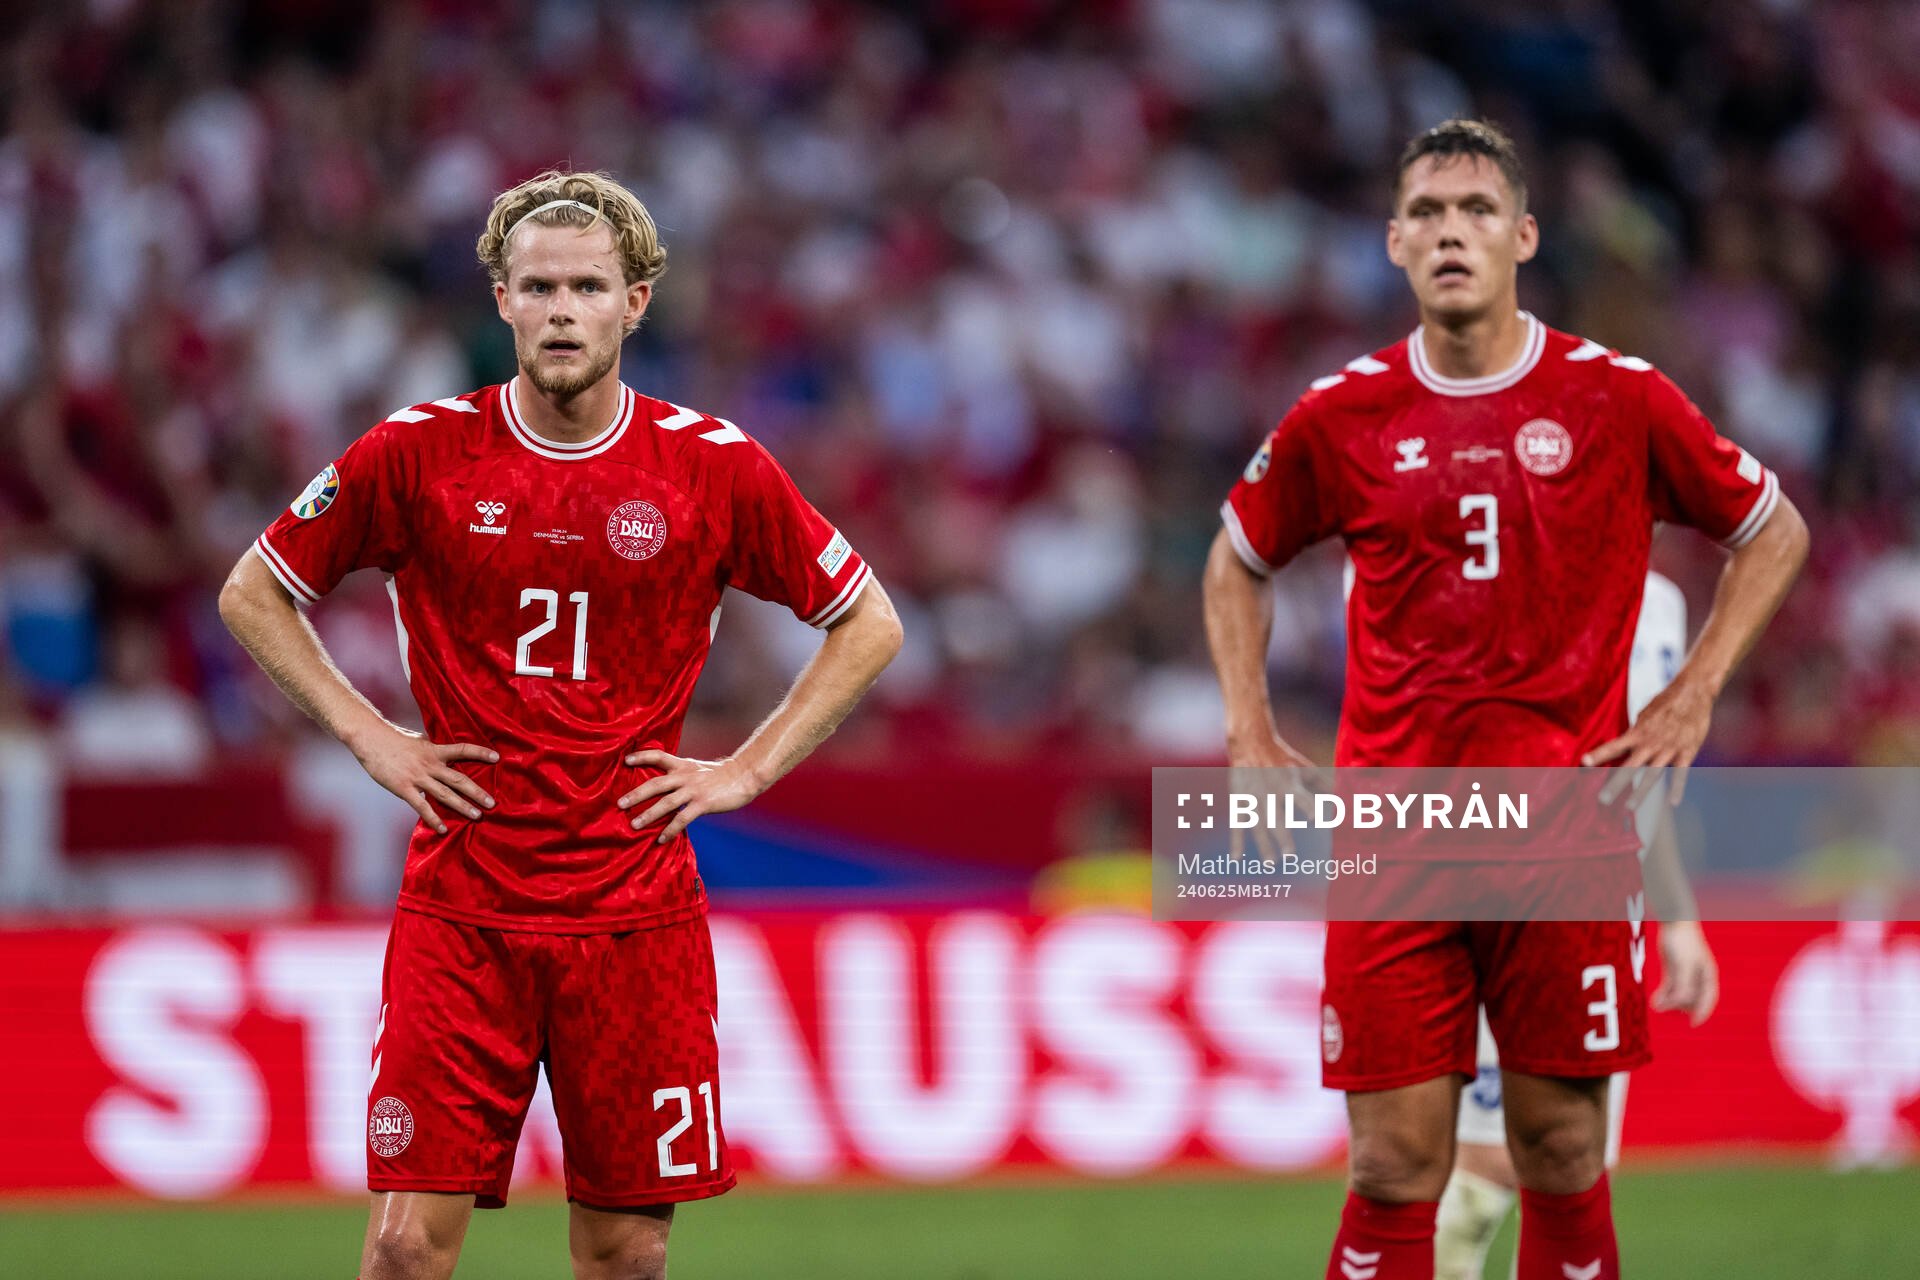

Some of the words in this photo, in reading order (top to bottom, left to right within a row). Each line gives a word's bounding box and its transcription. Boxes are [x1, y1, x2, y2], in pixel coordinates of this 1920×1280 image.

[469, 522, 507, 535] hummel
[609, 515, 621, 549] DANSK
[649, 522, 665, 553] UNION
[619, 520, 655, 539] DBU
[1459, 493, 1500, 580] 3
[623, 549, 647, 559] 1889
[515, 587, 589, 681] 21
[1581, 963, 1621, 1053] 3
[84, 907, 1352, 1199] STAUSS
[375, 1117, 402, 1135] DBU
[400, 1114, 412, 1147] UNION
[652, 1080, 718, 1179] 21
[379, 1146, 399, 1155] 1889
